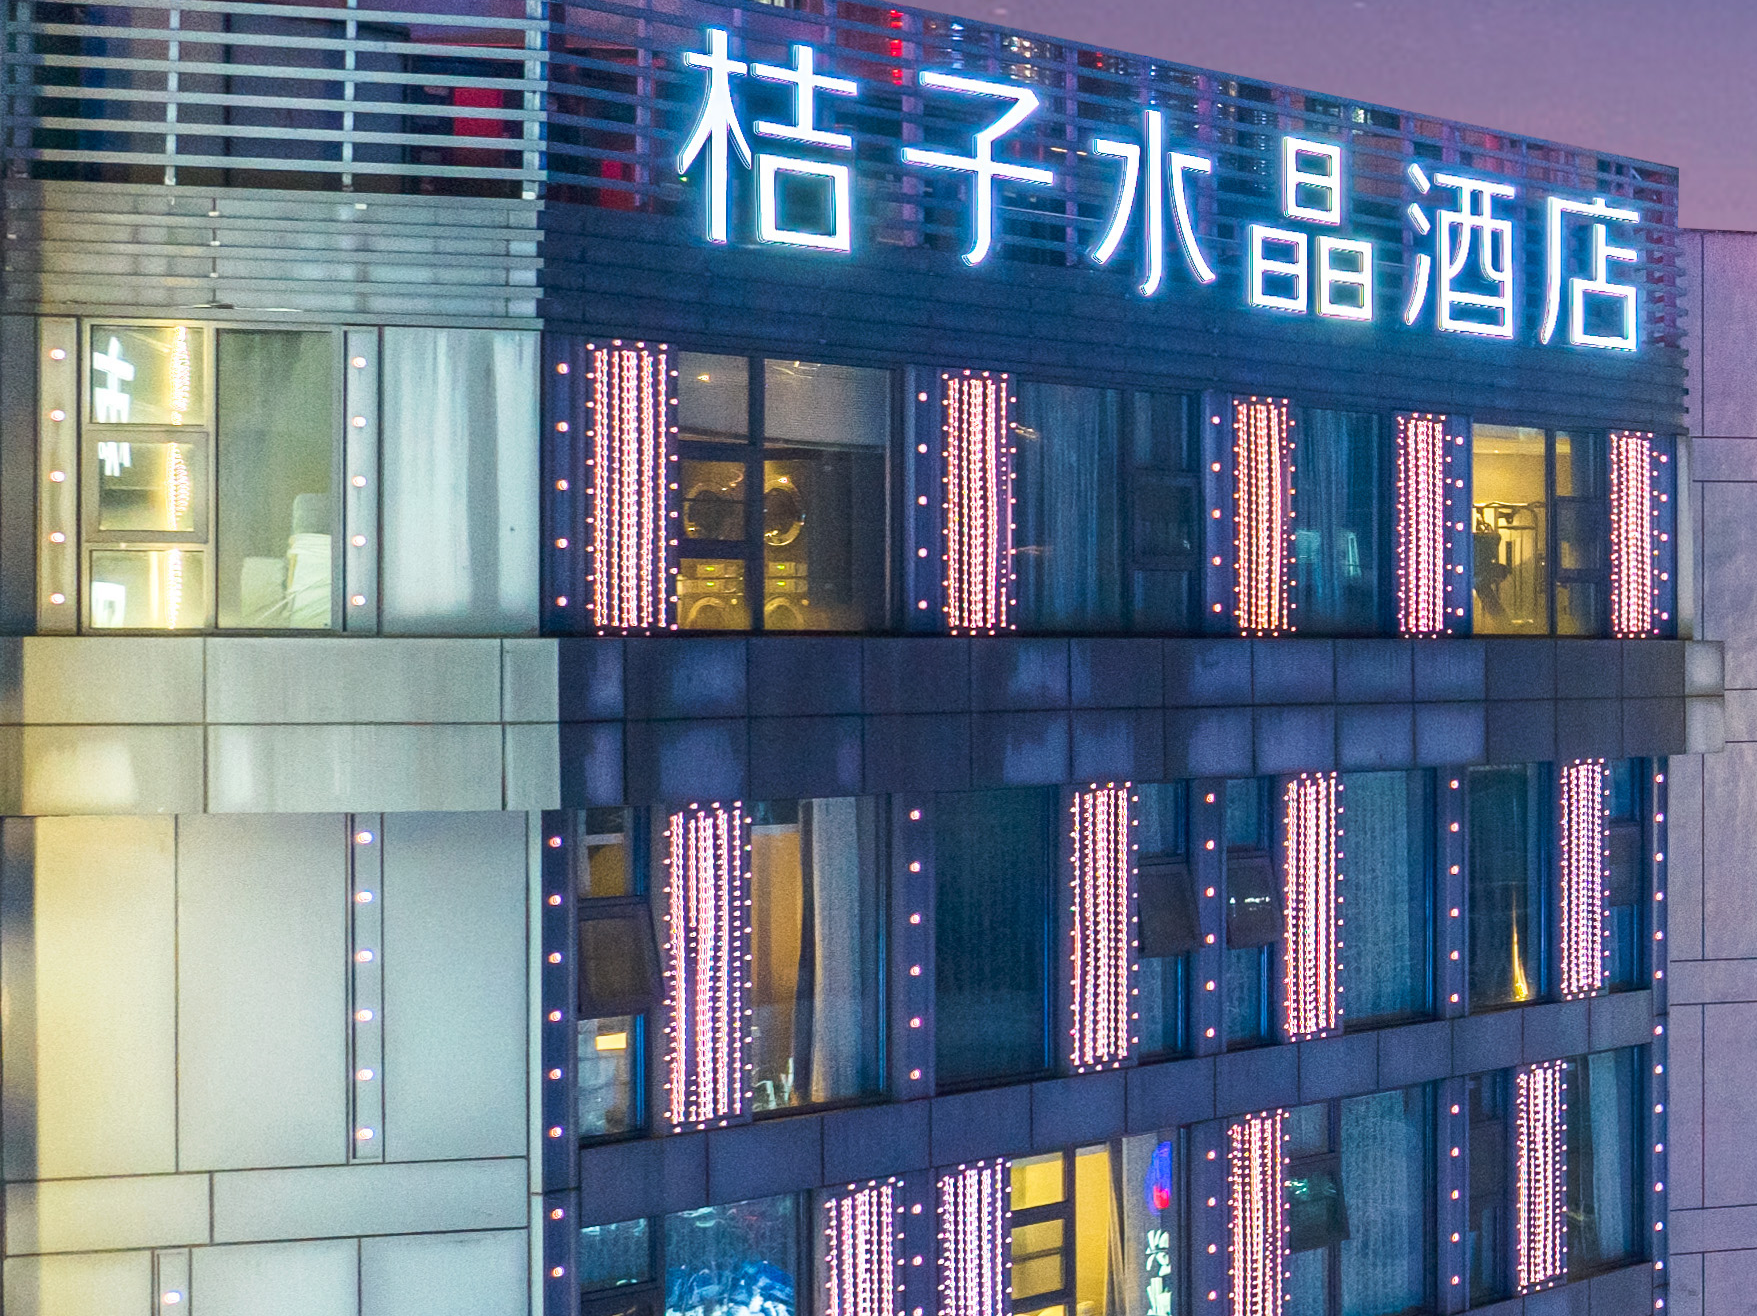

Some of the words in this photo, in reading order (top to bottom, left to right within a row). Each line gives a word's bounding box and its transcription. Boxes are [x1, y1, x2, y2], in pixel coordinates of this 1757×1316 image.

[677, 27, 1642, 353] 桔子水晶酒店
